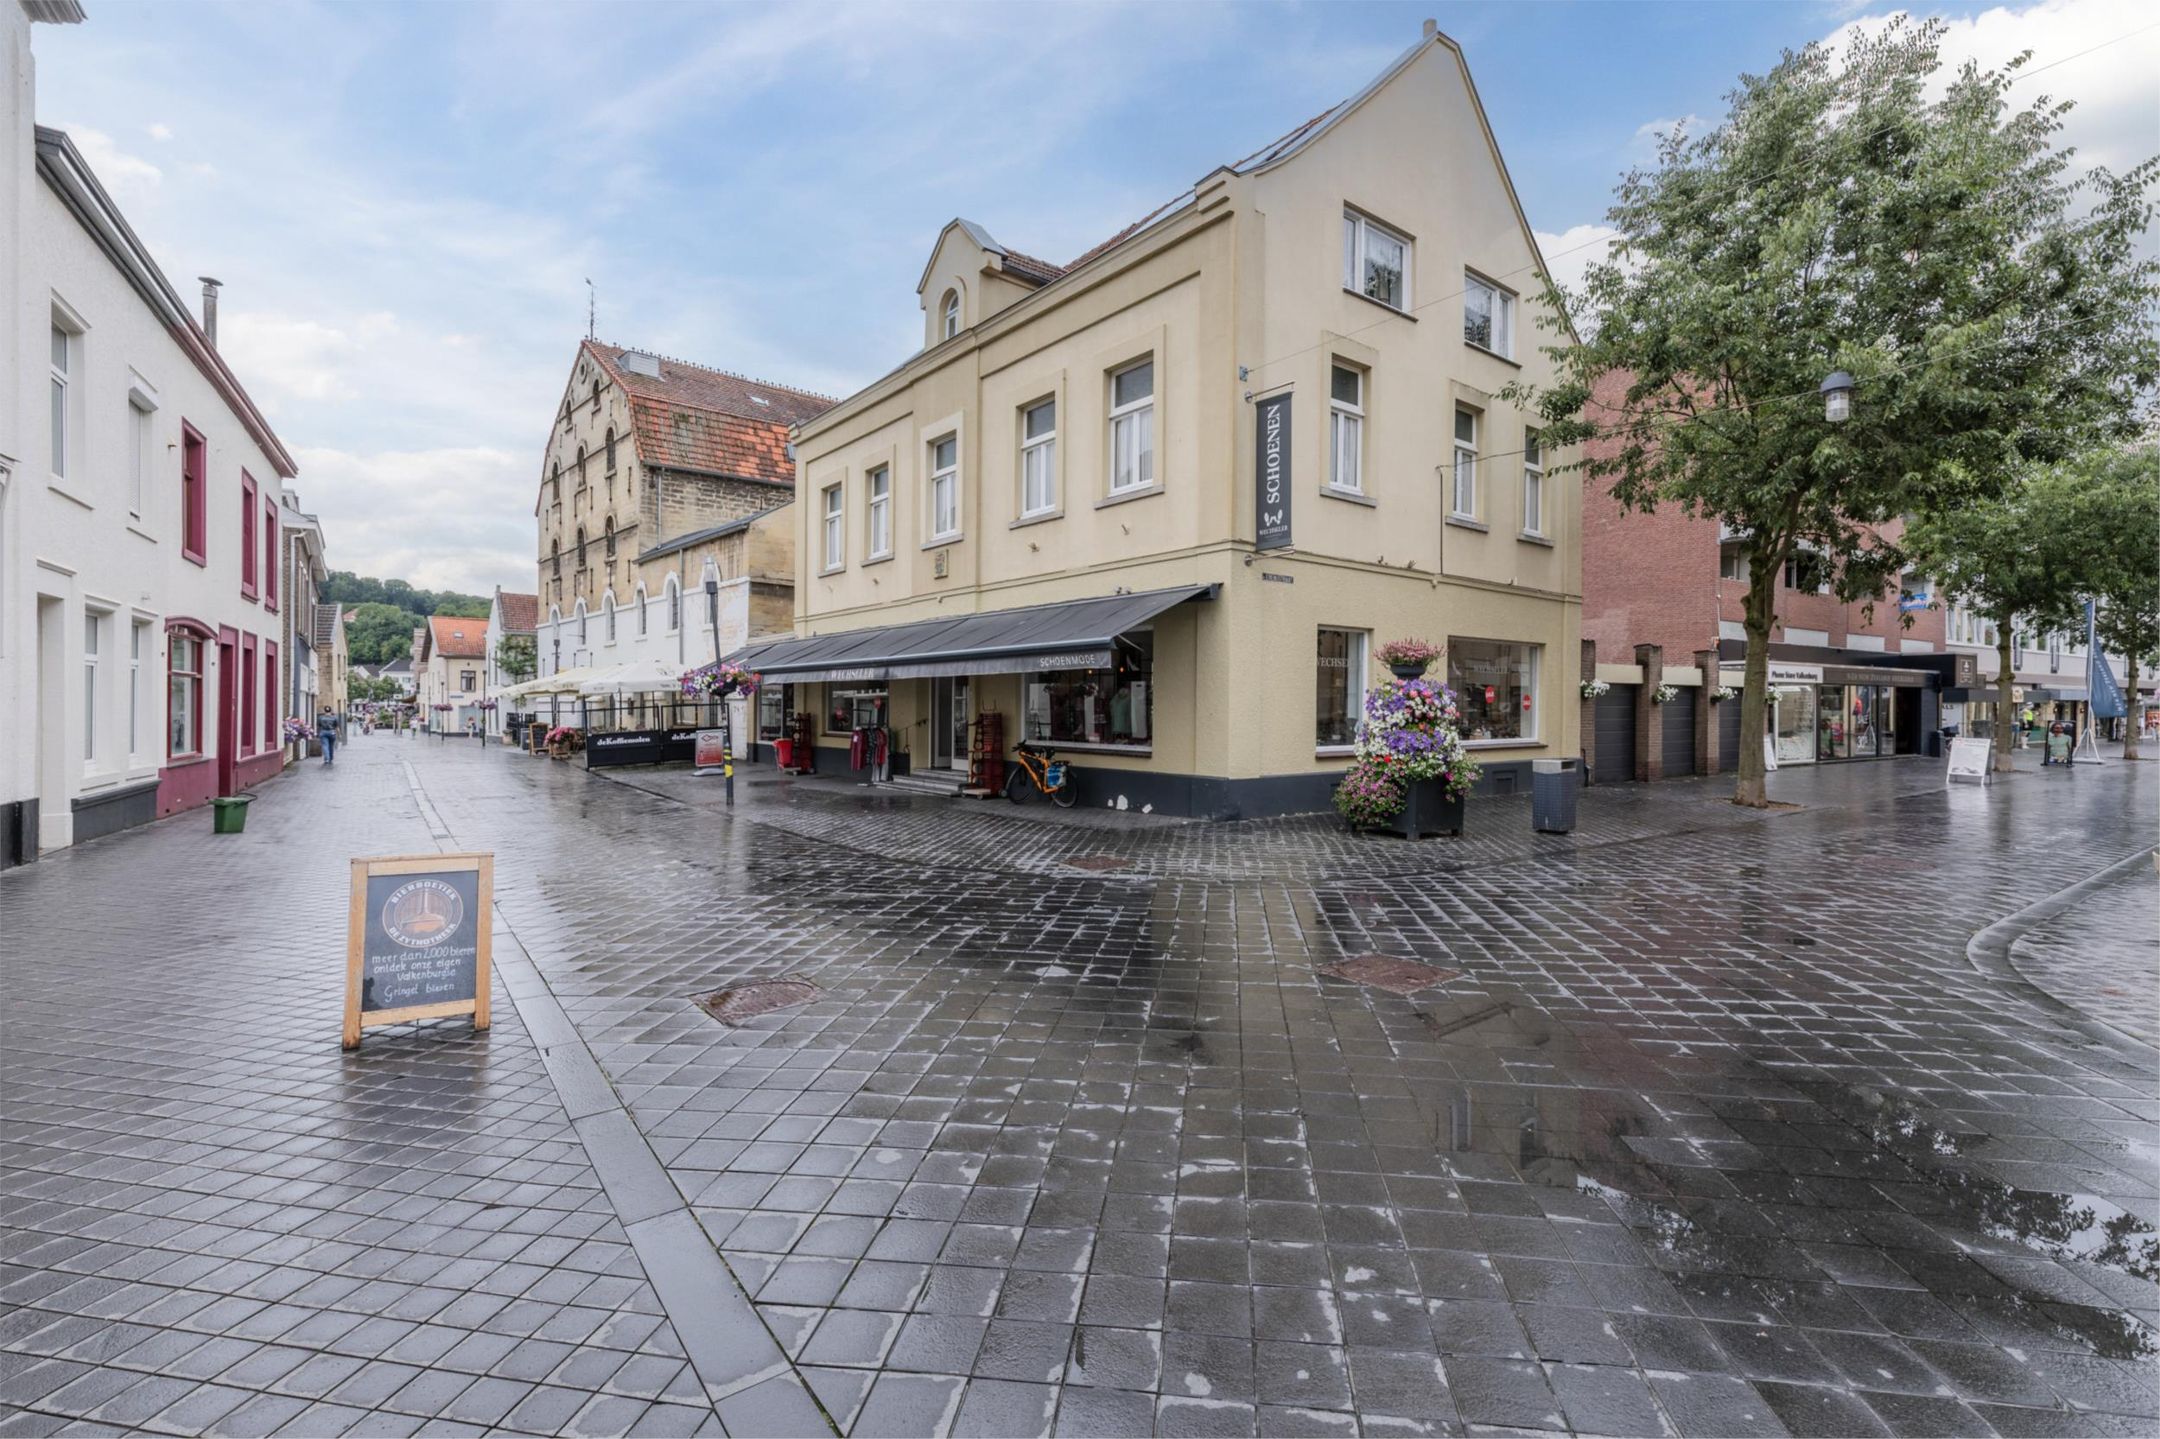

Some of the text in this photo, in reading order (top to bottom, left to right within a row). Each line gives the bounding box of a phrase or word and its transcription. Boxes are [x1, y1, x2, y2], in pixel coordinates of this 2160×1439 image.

[1266, 404, 1280, 504] SCHOENEN
[1040, 654, 1096, 667] SCHOENMODE
[597, 735, 651, 746] deKoffiemolen
[391, 881, 457, 904] BIERBOETIEK
[372, 954, 398, 965] meer
[400, 951, 422, 961] dan
[373, 958, 461, 974] ontdek onze eigen
